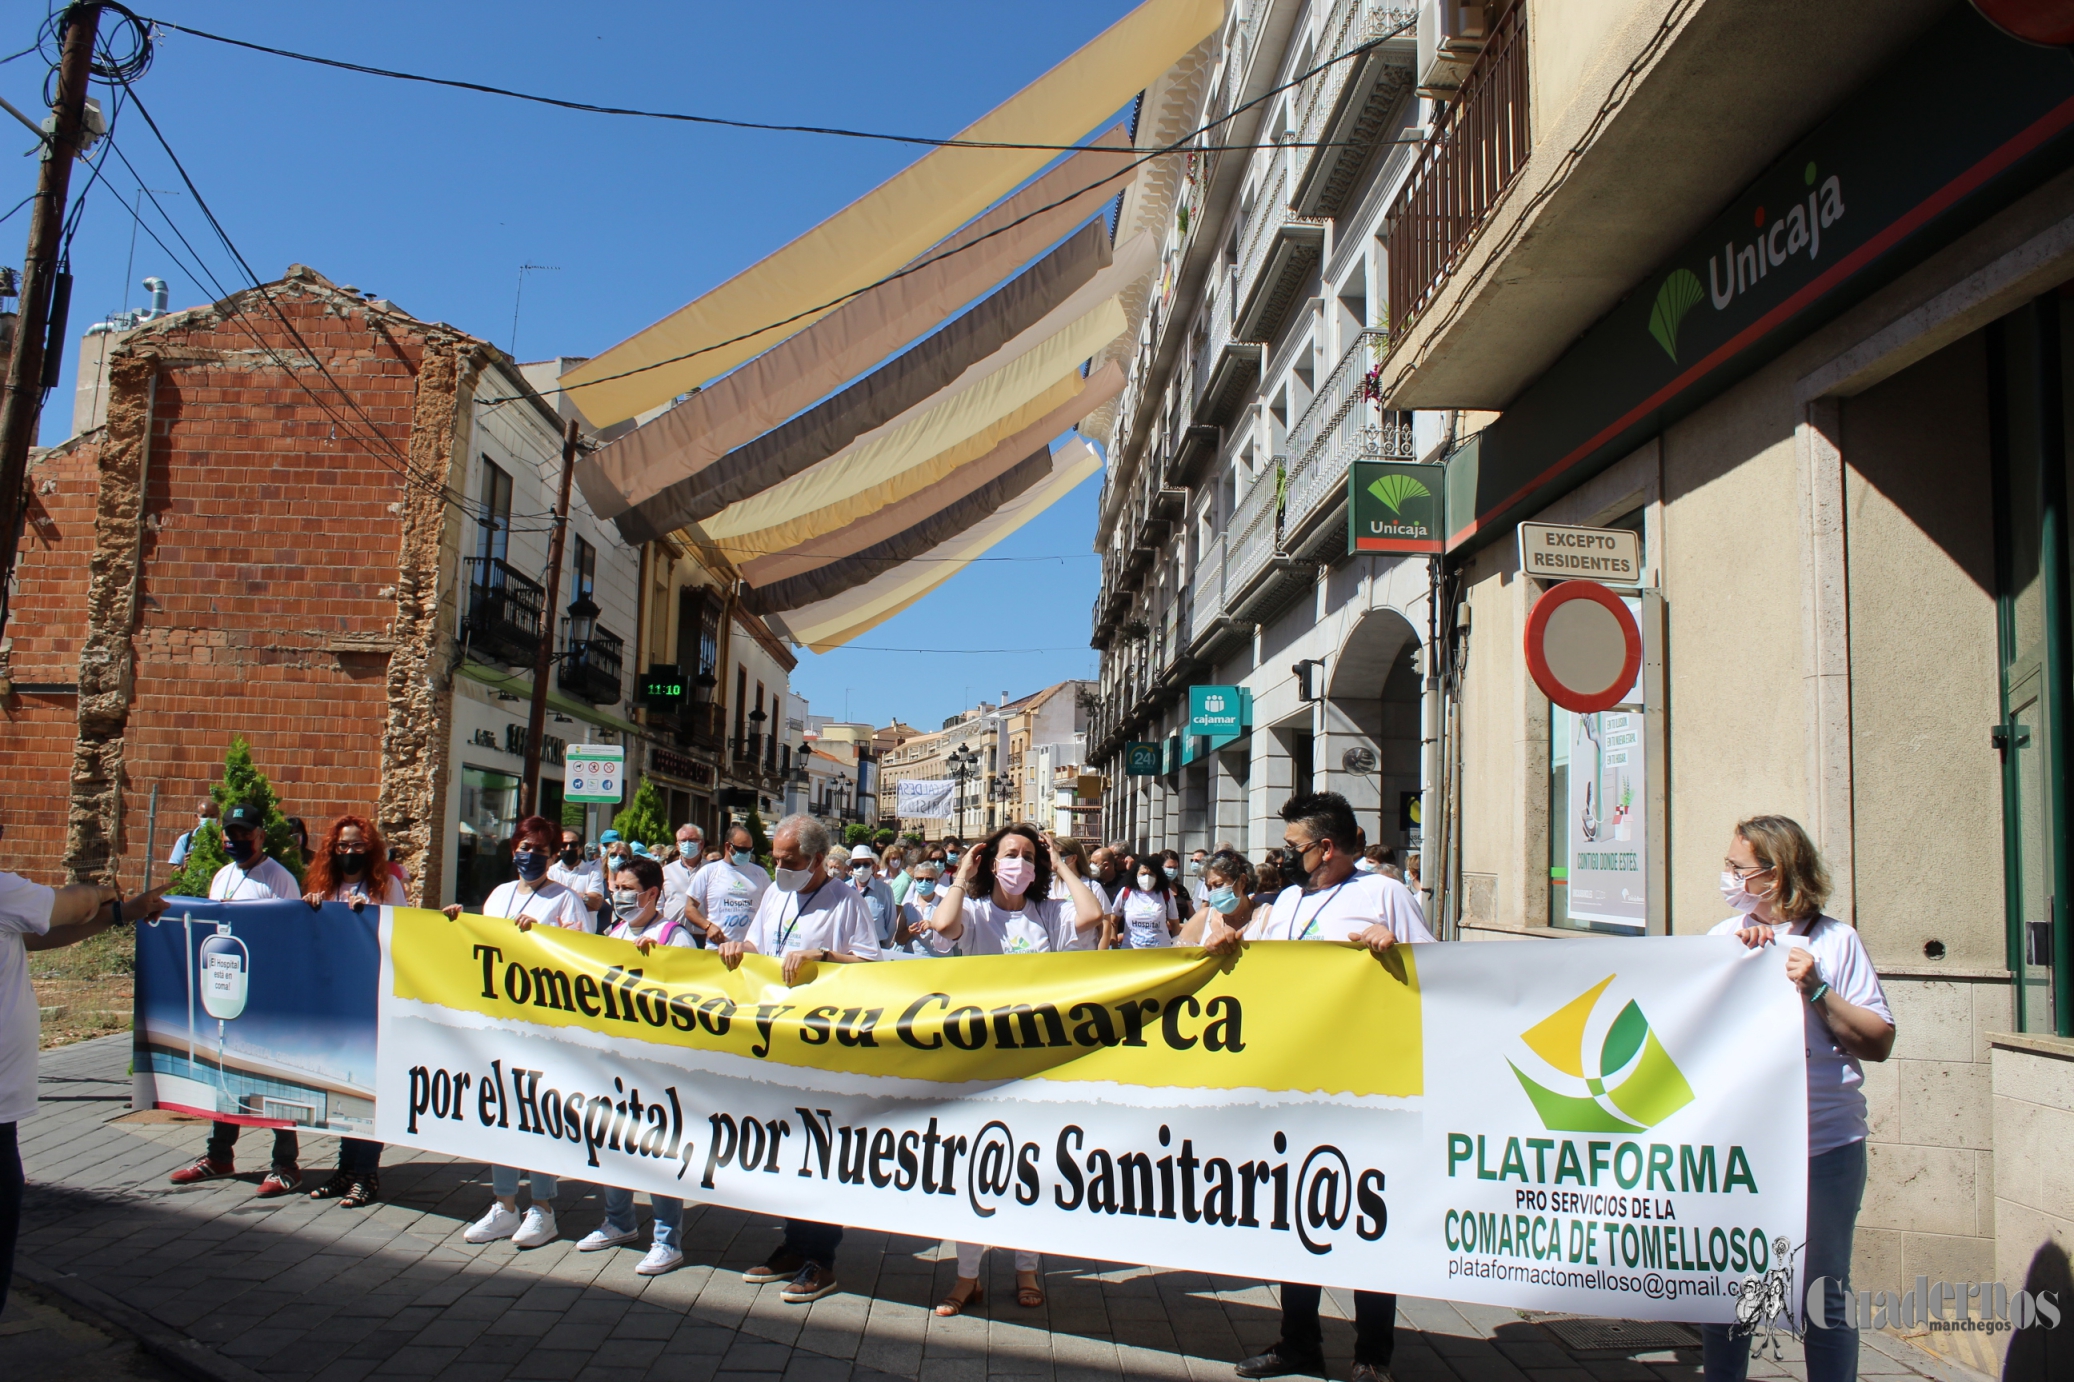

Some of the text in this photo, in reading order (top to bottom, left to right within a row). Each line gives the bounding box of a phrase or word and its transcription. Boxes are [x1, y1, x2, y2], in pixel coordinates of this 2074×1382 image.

[1709, 161, 1845, 311] Unicaja
[1370, 519, 1428, 538] Unicaja
[1545, 532, 1616, 550] EXCEPTO
[1534, 552, 1630, 573] RESIDENTES
[648, 684, 681, 696] 11:10
[1193, 714, 1236, 726] cajamar
[1577, 849, 1638, 871] CONTIGO DONDE ESTÉS.
[723, 899, 753, 909] Hospital
[1131, 919, 1161, 930] Hospital
[216, 958, 239, 970] Hospital
[214, 971, 233, 980] está en
[214, 982, 231, 991] coma!
[473, 944, 1246, 1058] Tomelloso y su Comarca
[407, 1059, 1387, 1255] por el Hospital, por Nuestr@s Sanitari@s
[1448, 1132, 1758, 1194] PLATAFORMA
[1516, 1189, 1676, 1220] PRO SERVICIOS DE LA
[1445, 1209, 1769, 1274] COMARCA DE TOMELLOSO
[1449, 1256, 1767, 1300] plataformactomelloso@gmail.c
